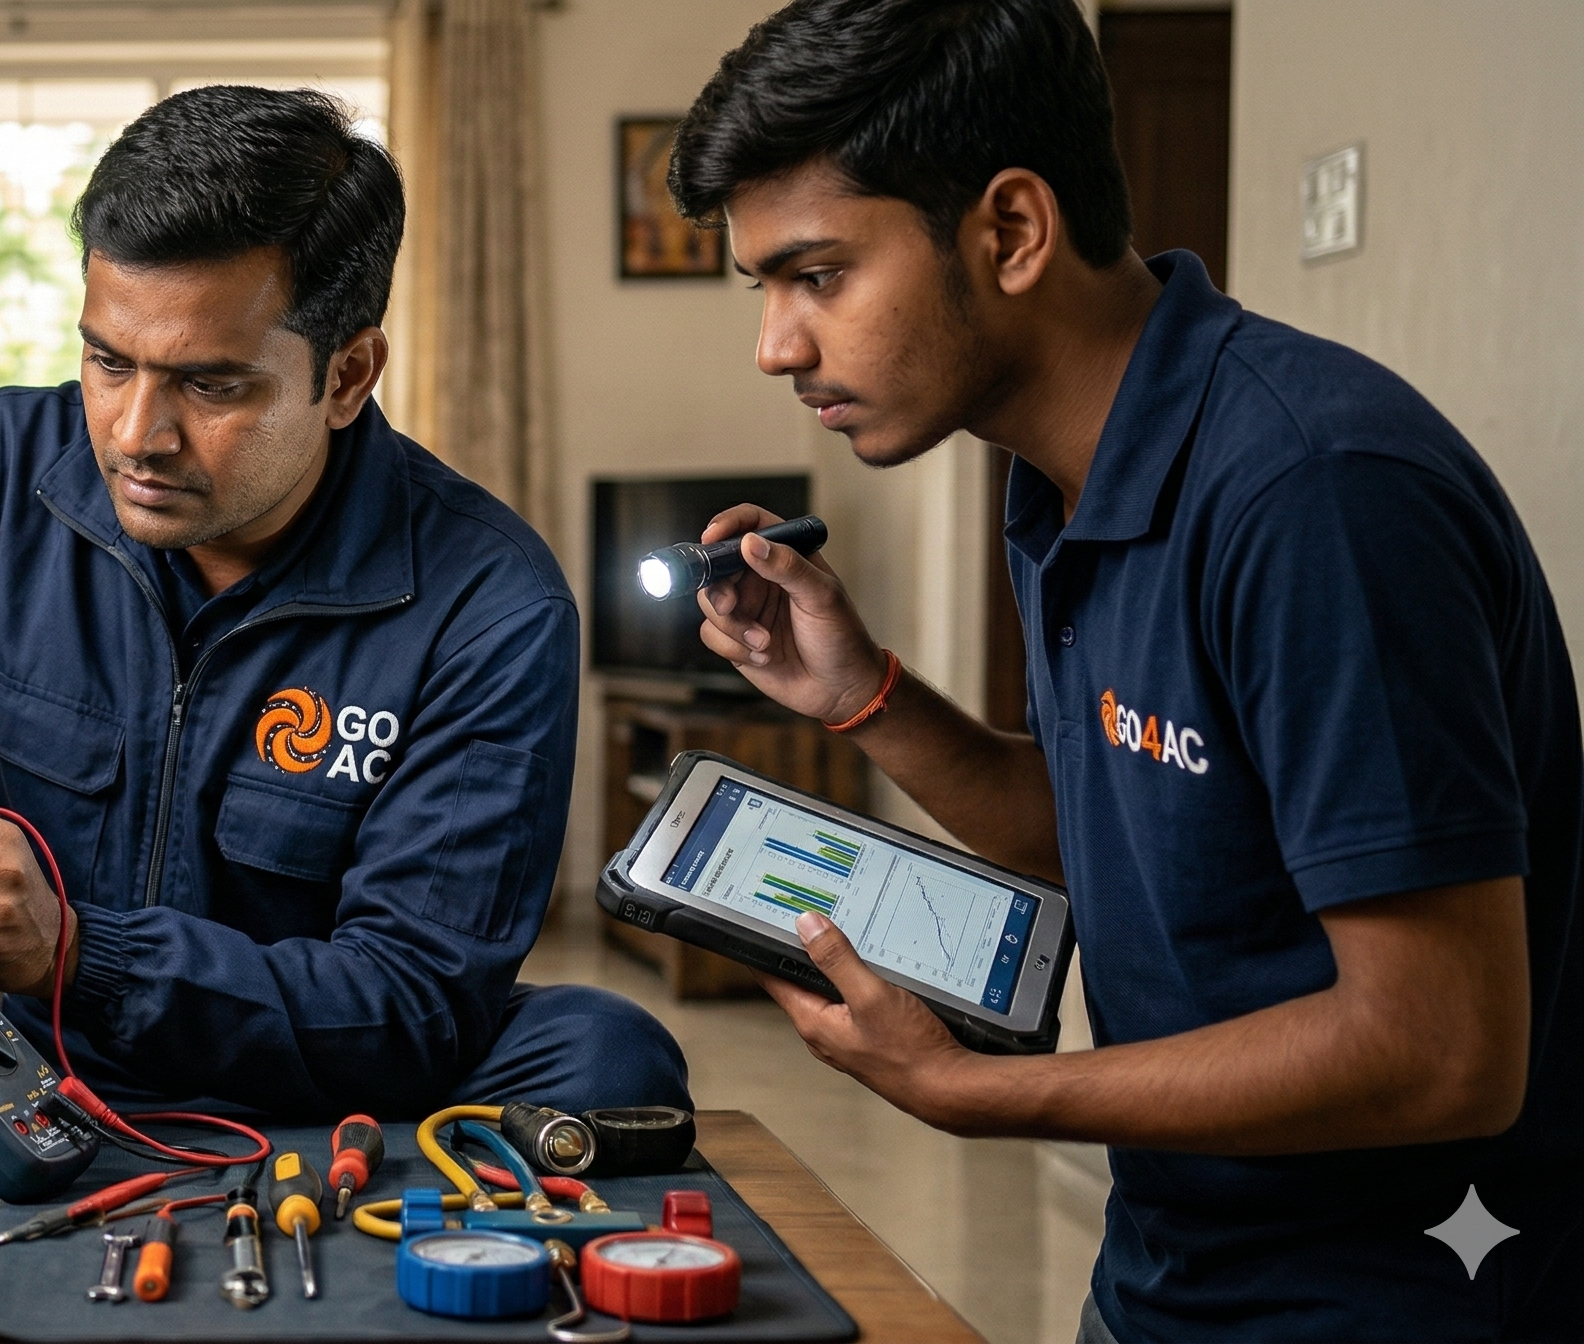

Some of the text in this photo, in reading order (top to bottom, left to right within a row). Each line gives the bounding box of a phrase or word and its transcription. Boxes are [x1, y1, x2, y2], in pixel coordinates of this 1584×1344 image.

[336, 705, 400, 748] GO
[1116, 704, 1209, 774] GO4AC
[326, 744, 392, 785] AC
